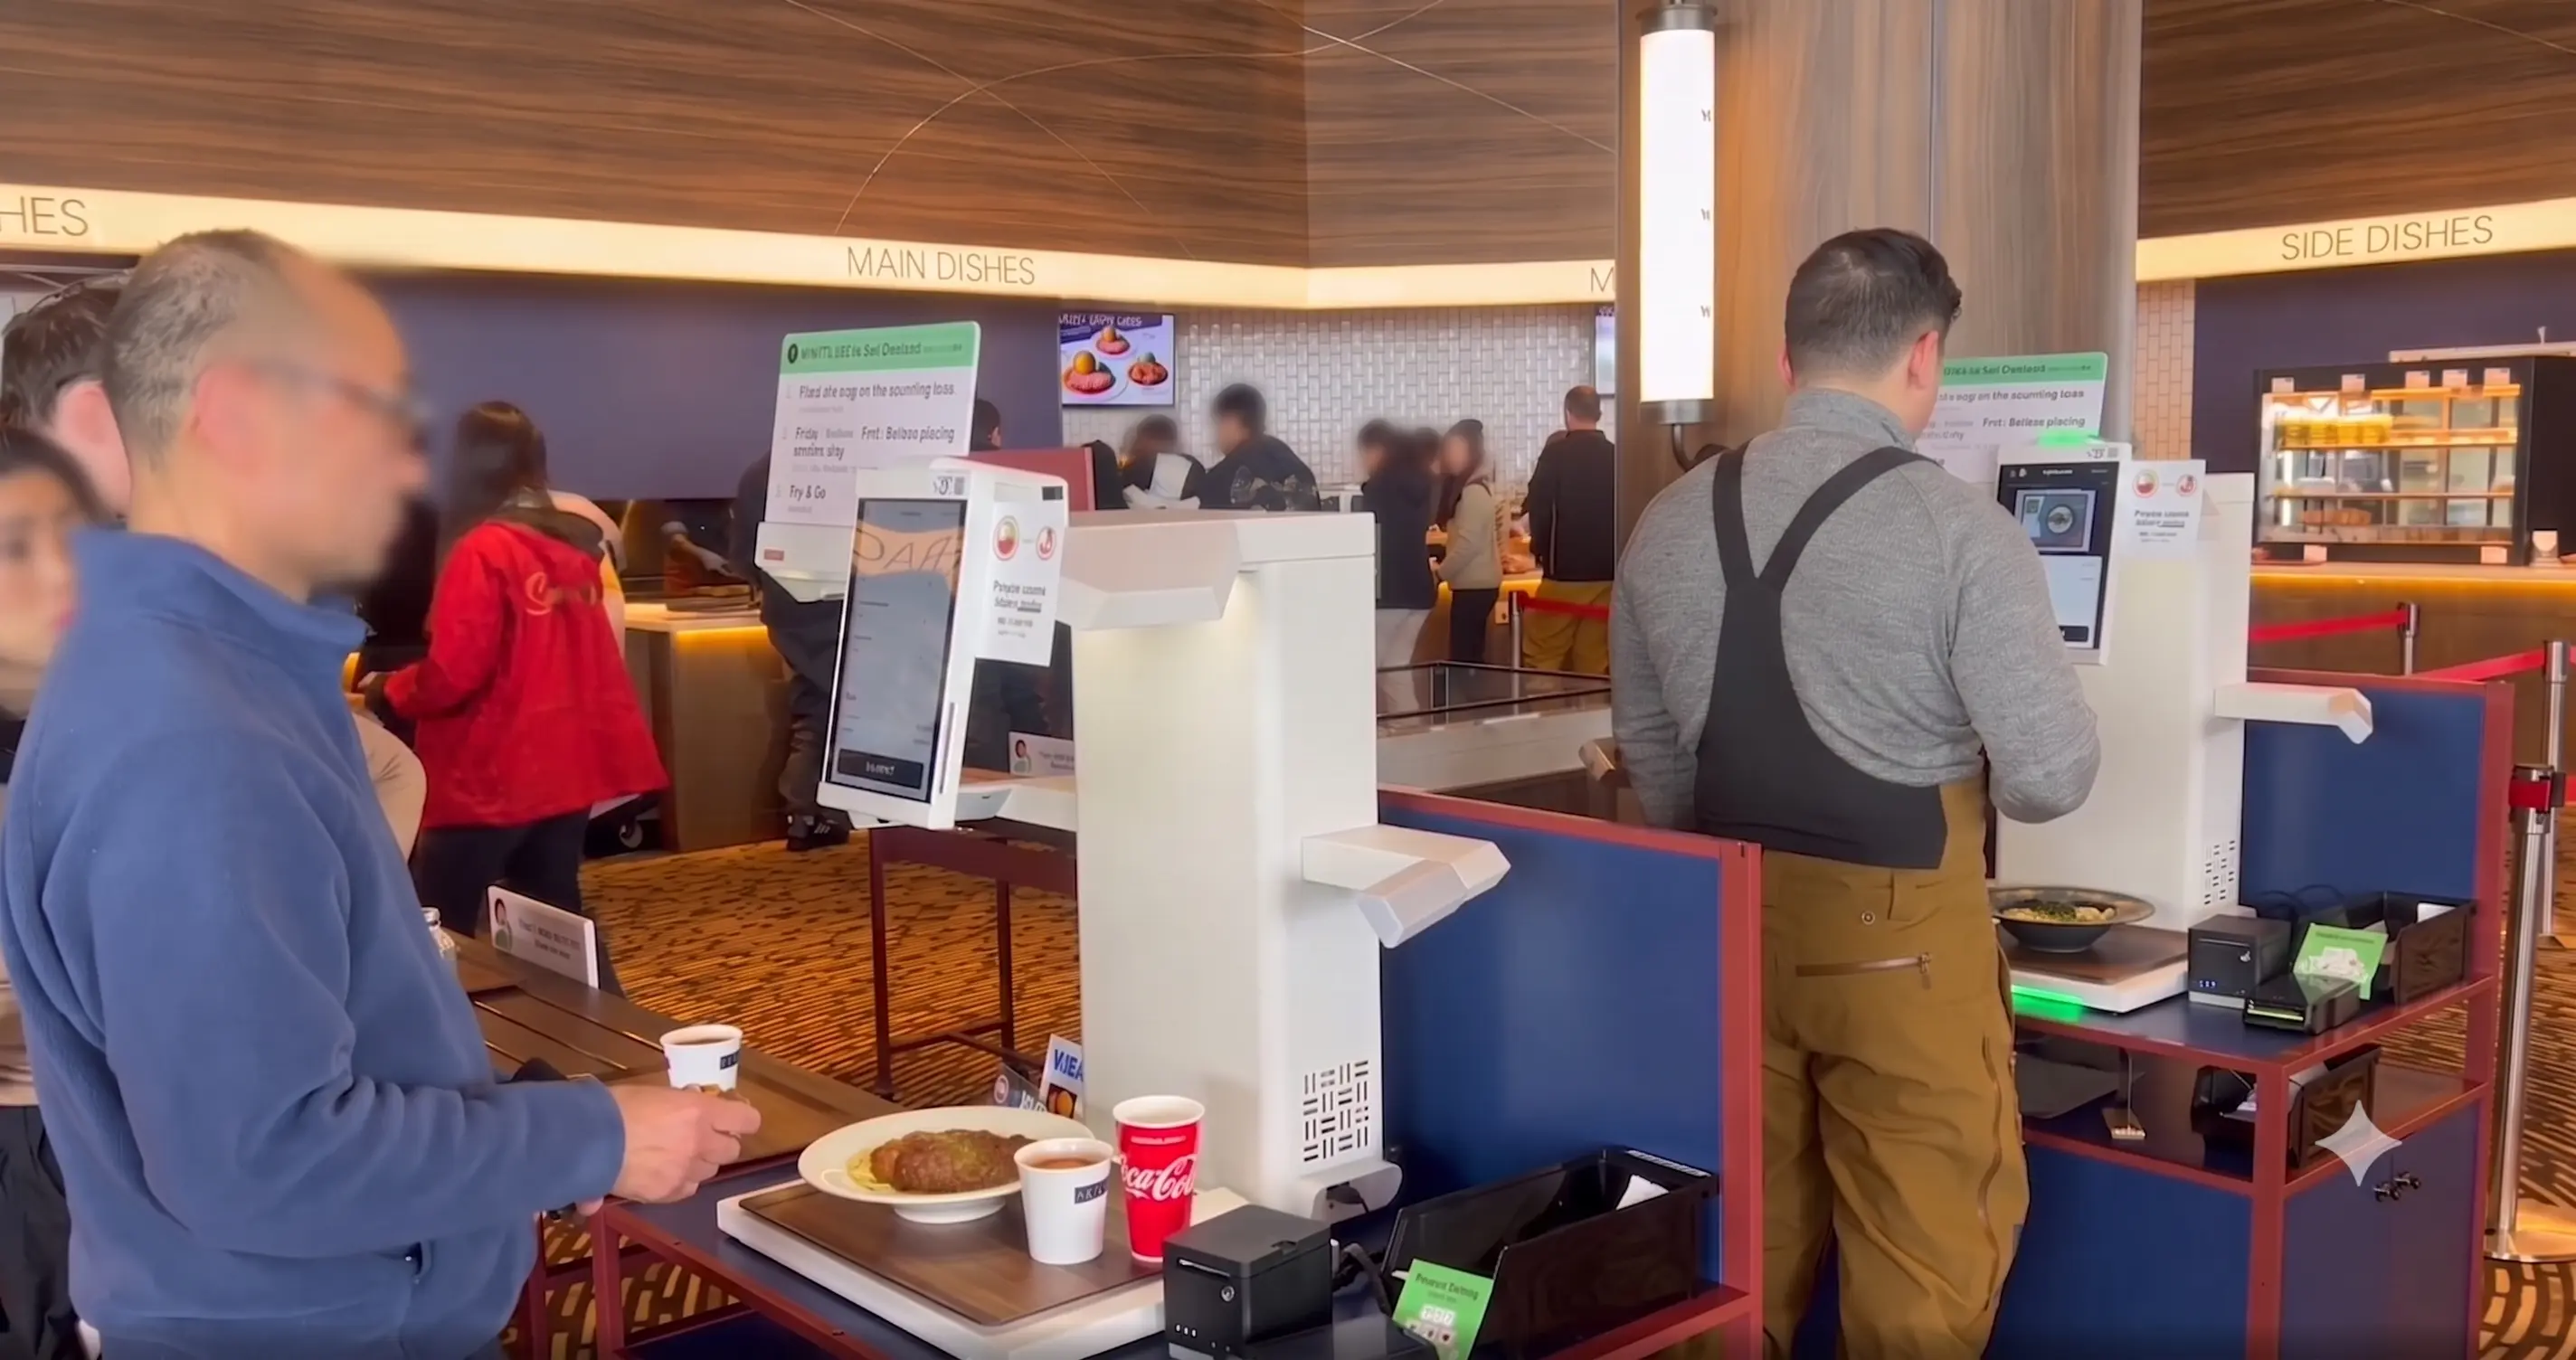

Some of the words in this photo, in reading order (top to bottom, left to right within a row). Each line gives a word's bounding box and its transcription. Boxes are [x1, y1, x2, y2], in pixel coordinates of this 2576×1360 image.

[0, 195, 89, 236] HES
[2281, 228, 2353, 260] SIDE
[2367, 214, 2494, 253] DISHES
[848, 246, 925, 279] MAIN
[937, 251, 1036, 286] DISHES
[873, 384, 887, 397] the
[1993, 391, 2009, 401] the
[790, 485, 804, 501] Fry
[814, 486, 827, 499] Go
